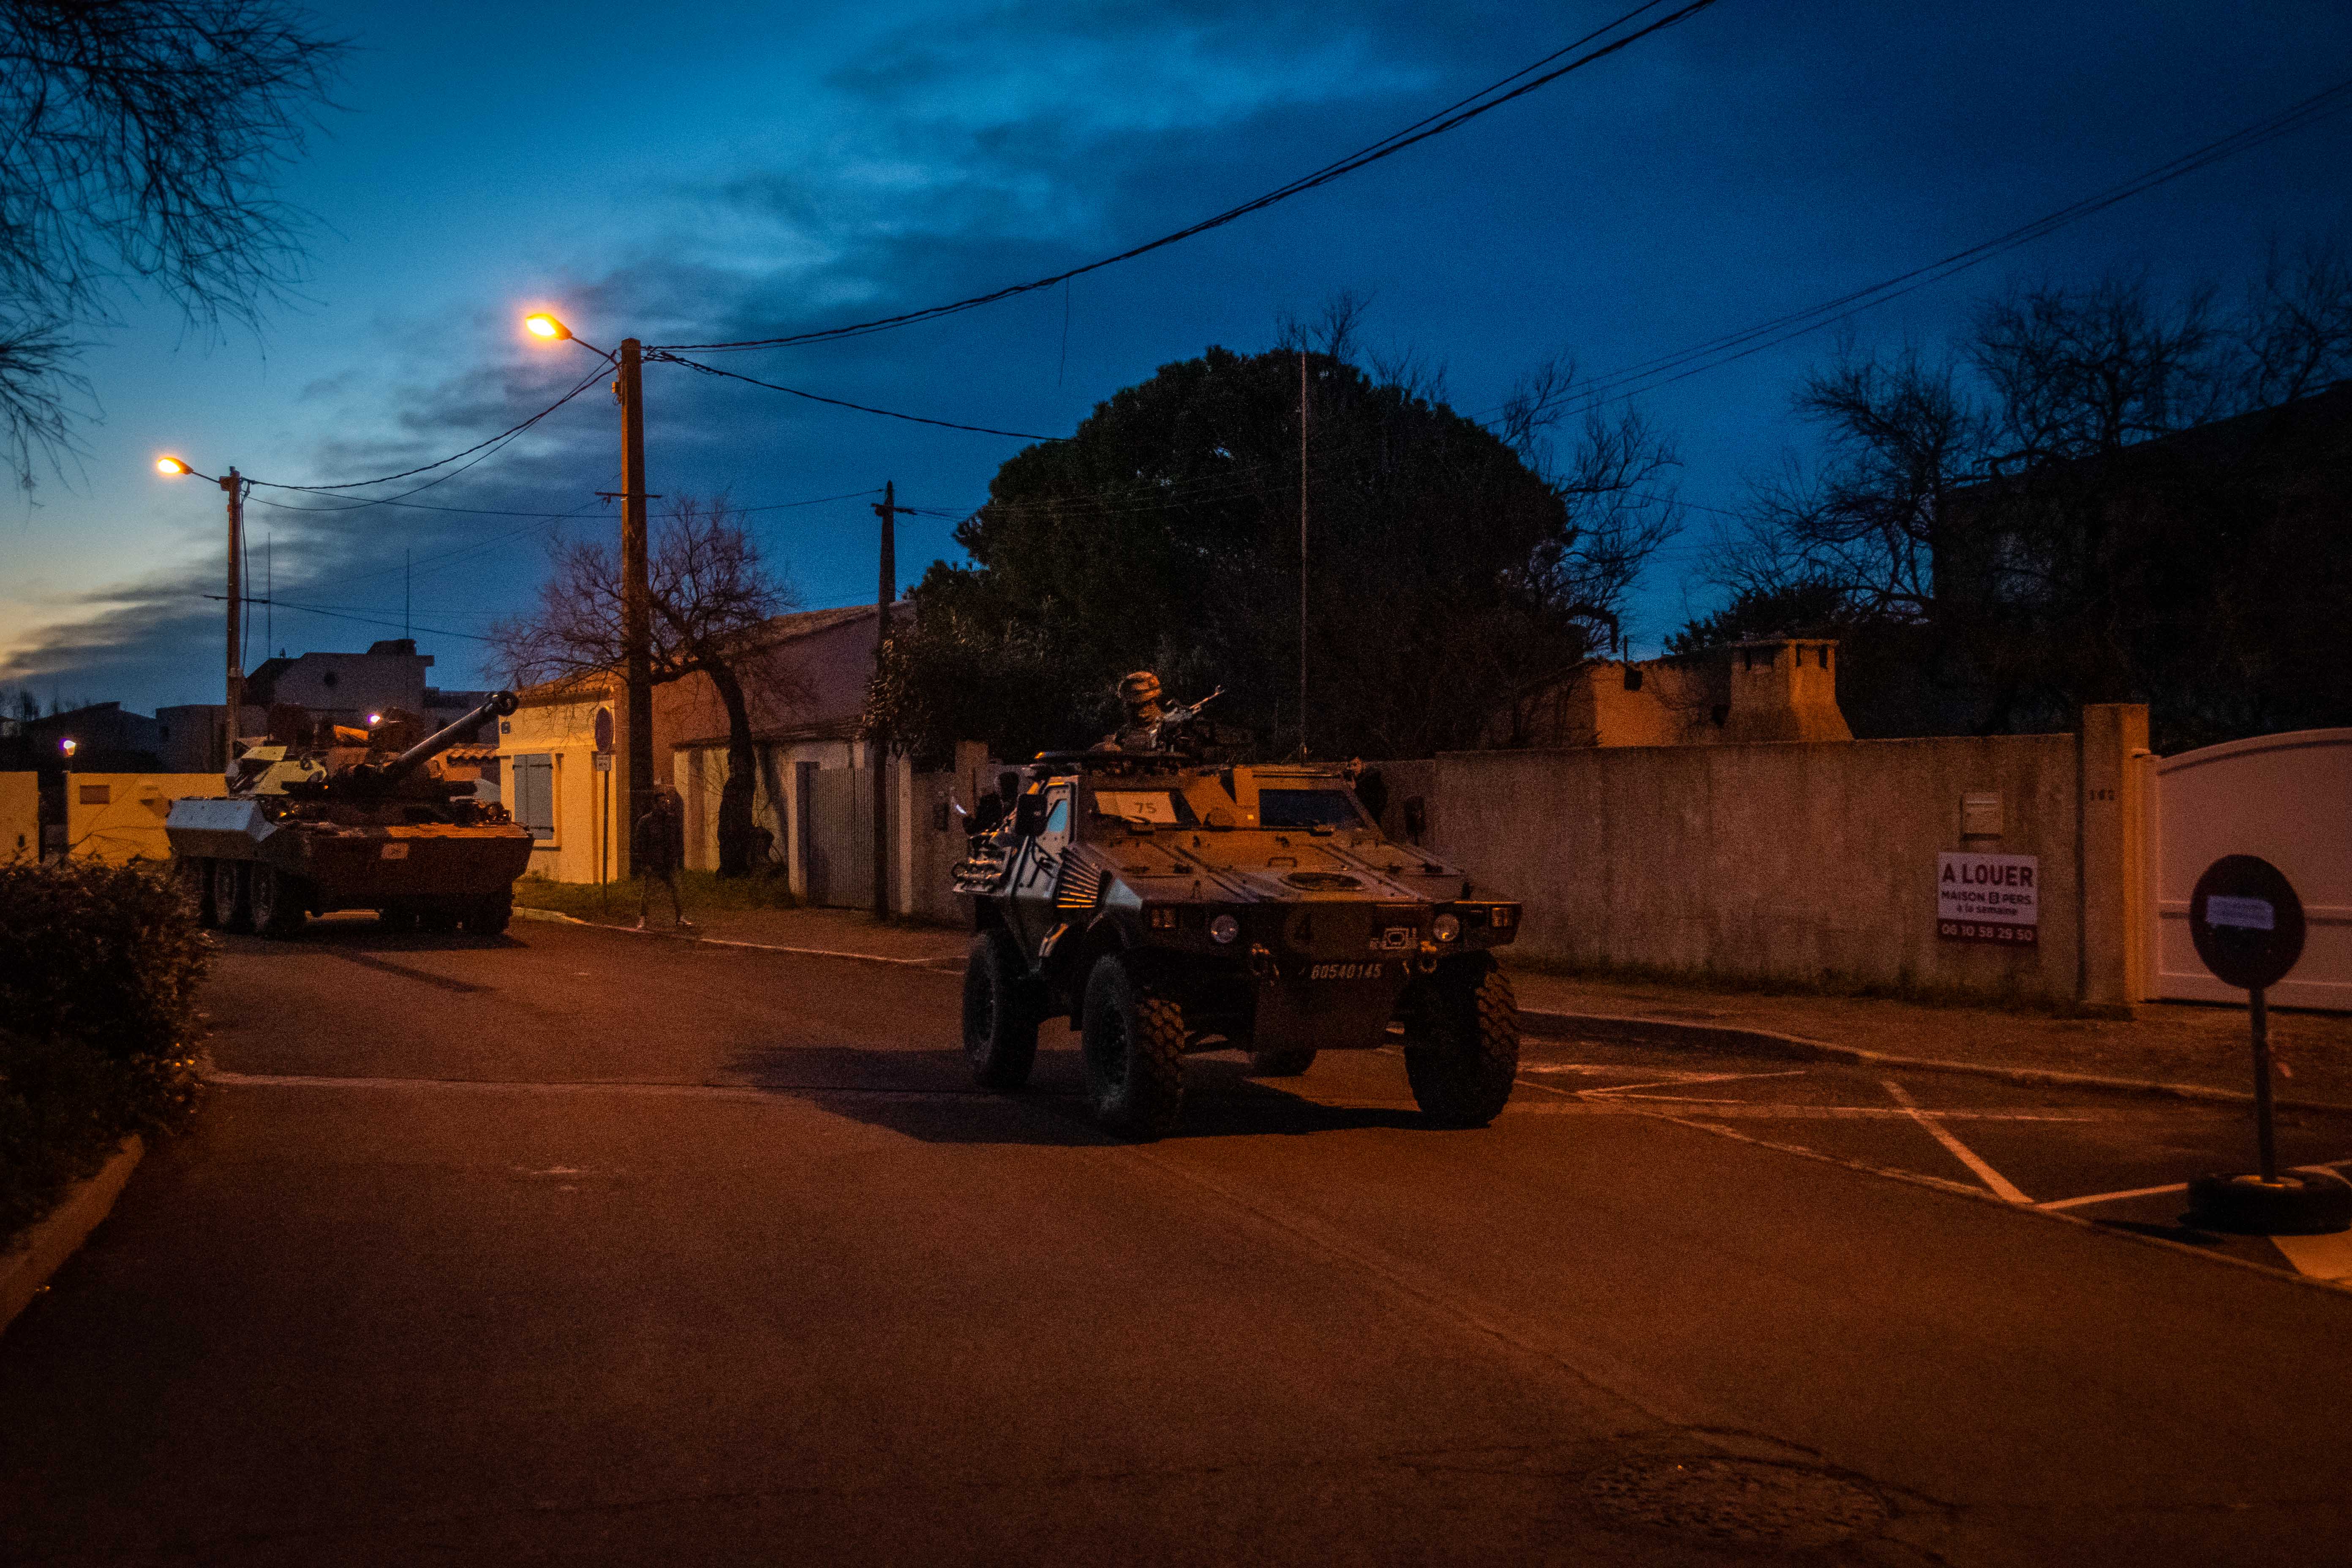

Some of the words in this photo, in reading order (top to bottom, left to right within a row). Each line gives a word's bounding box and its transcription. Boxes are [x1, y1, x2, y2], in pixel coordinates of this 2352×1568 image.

[1135, 803, 1157, 813] 75
[1943, 863, 1955, 882] A
[1963, 864, 2033, 886] LOUER
[1941, 891, 1985, 901] MAISON
[1976, 906, 2017, 915] semaine
[1961, 925, 1975, 936] 10
[1979, 926, 1993, 937] 58
[1998, 928, 2013, 939] 29
[2016, 929, 2033, 941] 50
